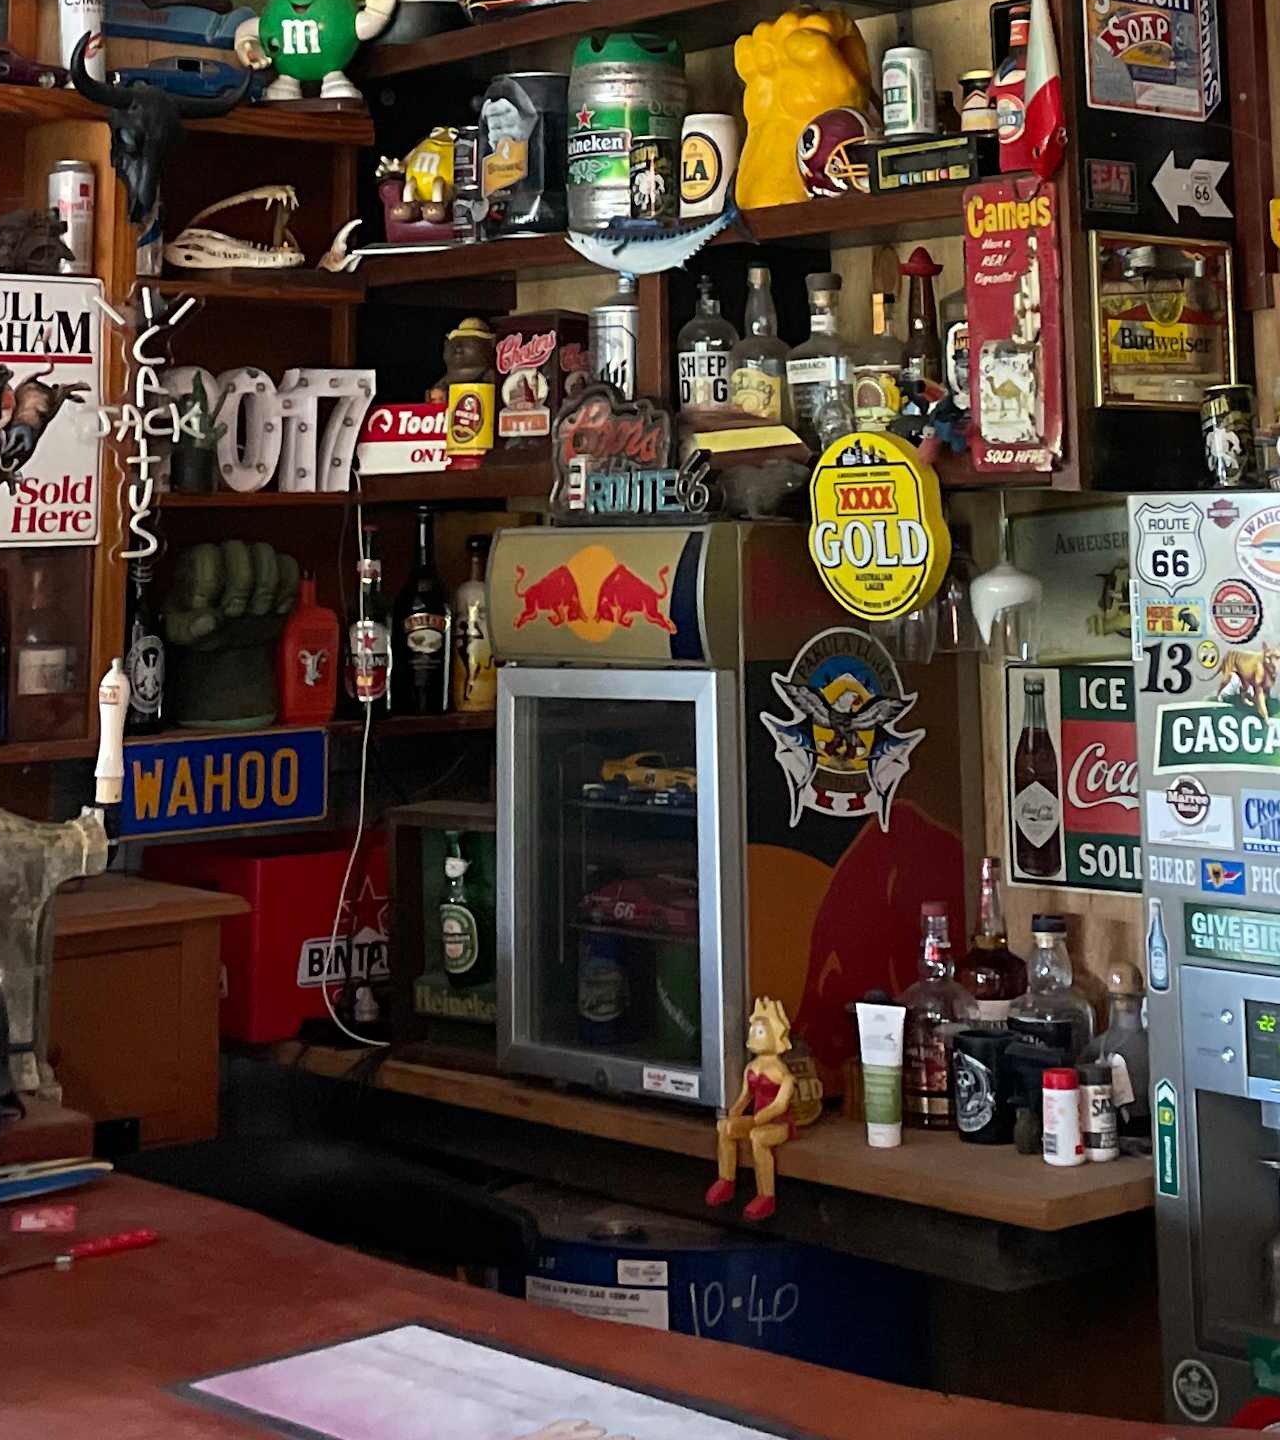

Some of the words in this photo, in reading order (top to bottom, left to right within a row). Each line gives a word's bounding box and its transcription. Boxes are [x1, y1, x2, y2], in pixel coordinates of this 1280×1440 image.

[282, 18, 321, 54] m
[1109, 12, 1169, 47] SOAP
[967, 197, 1051, 238] Camels
[1119, 327, 1211, 355] Budweiser
[679, 356, 728, 378] SHEEP
[99, 404, 206, 442] JACK
[18, 475, 93, 505] Sold
[588, 470, 681, 512] ROUTE
[840, 488, 892, 511] XXXX
[11, 506, 92, 533] Here
[1149, 518, 1190, 531] ROUTE
[815, 520, 928, 568] GOLD
[1163, 536, 1175, 546] US
[856, 573, 892, 582] AUSTRALIAN
[1152, 550, 1190, 577] 66
[865, 583, 884, 591] LAGER
[1140, 642, 1192, 694] 13
[1079, 677, 1127, 711] ICE
[133, 747, 299, 822] WAHOO
[1149, 856, 1197, 886] BIERE
[1192, 912, 1241, 938] GIVE
